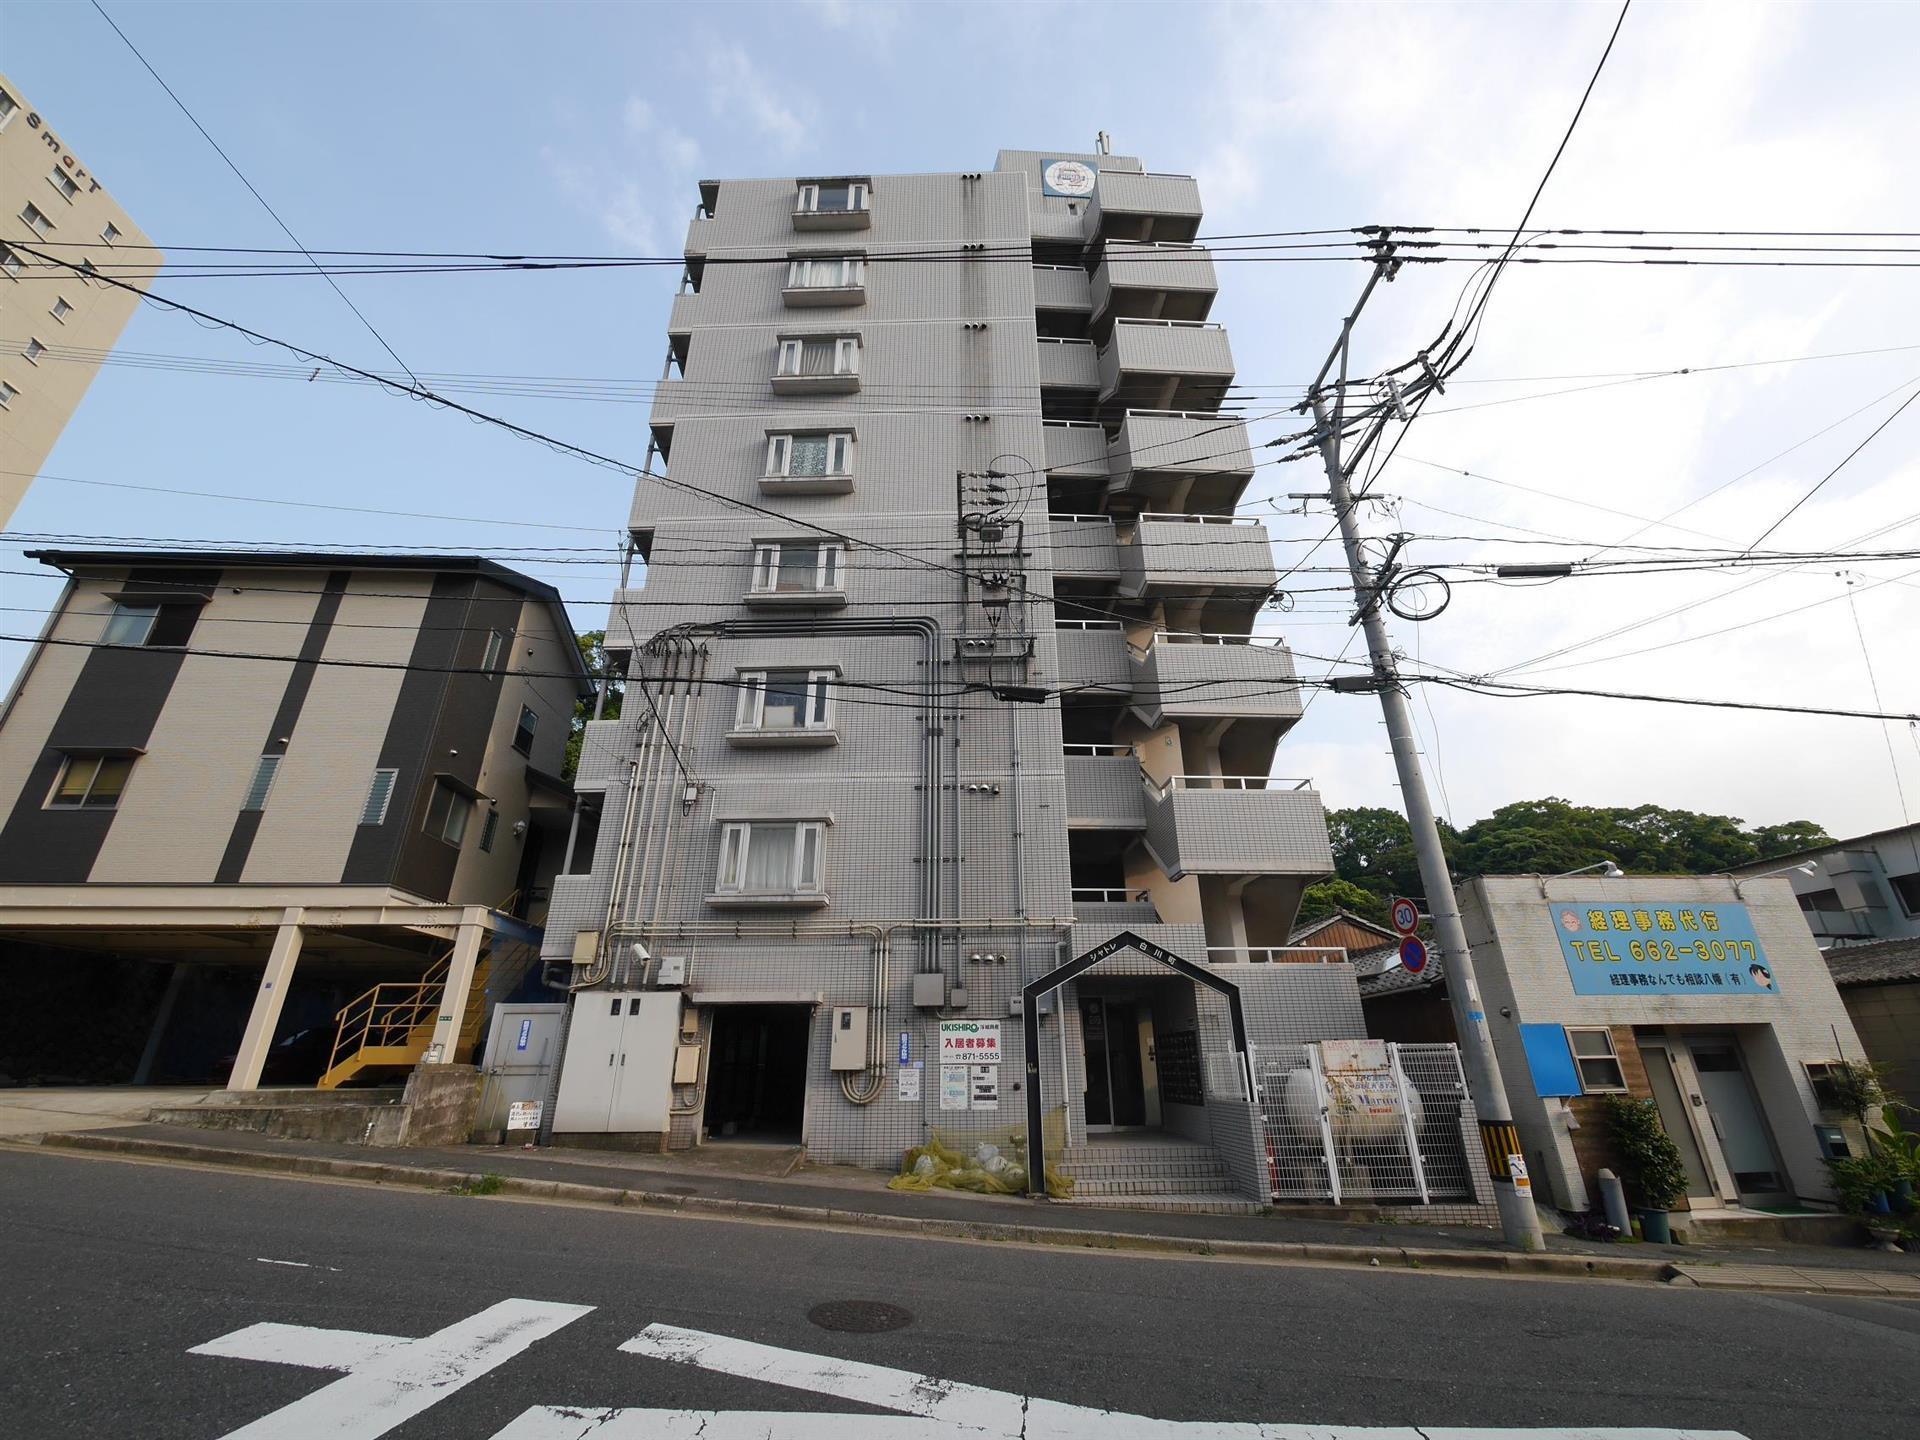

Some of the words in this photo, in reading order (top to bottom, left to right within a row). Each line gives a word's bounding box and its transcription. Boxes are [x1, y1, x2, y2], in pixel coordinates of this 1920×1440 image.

[1397, 908, 1413, 925] 30
[1587, 909, 1720, 932] 経理事務代行
[1090, 943, 1117, 962] シャトレ
[1139, 942, 1176, 965] 白川町
[1570, 940, 1621, 961] TEL
[1629, 940, 1757, 961] 662-3077
[941, 1023, 979, 1033] UKISHIRO
[944, 1037, 997, 1049] 入居者募集
[962, 1052, 1000, 1061] 871-5555
